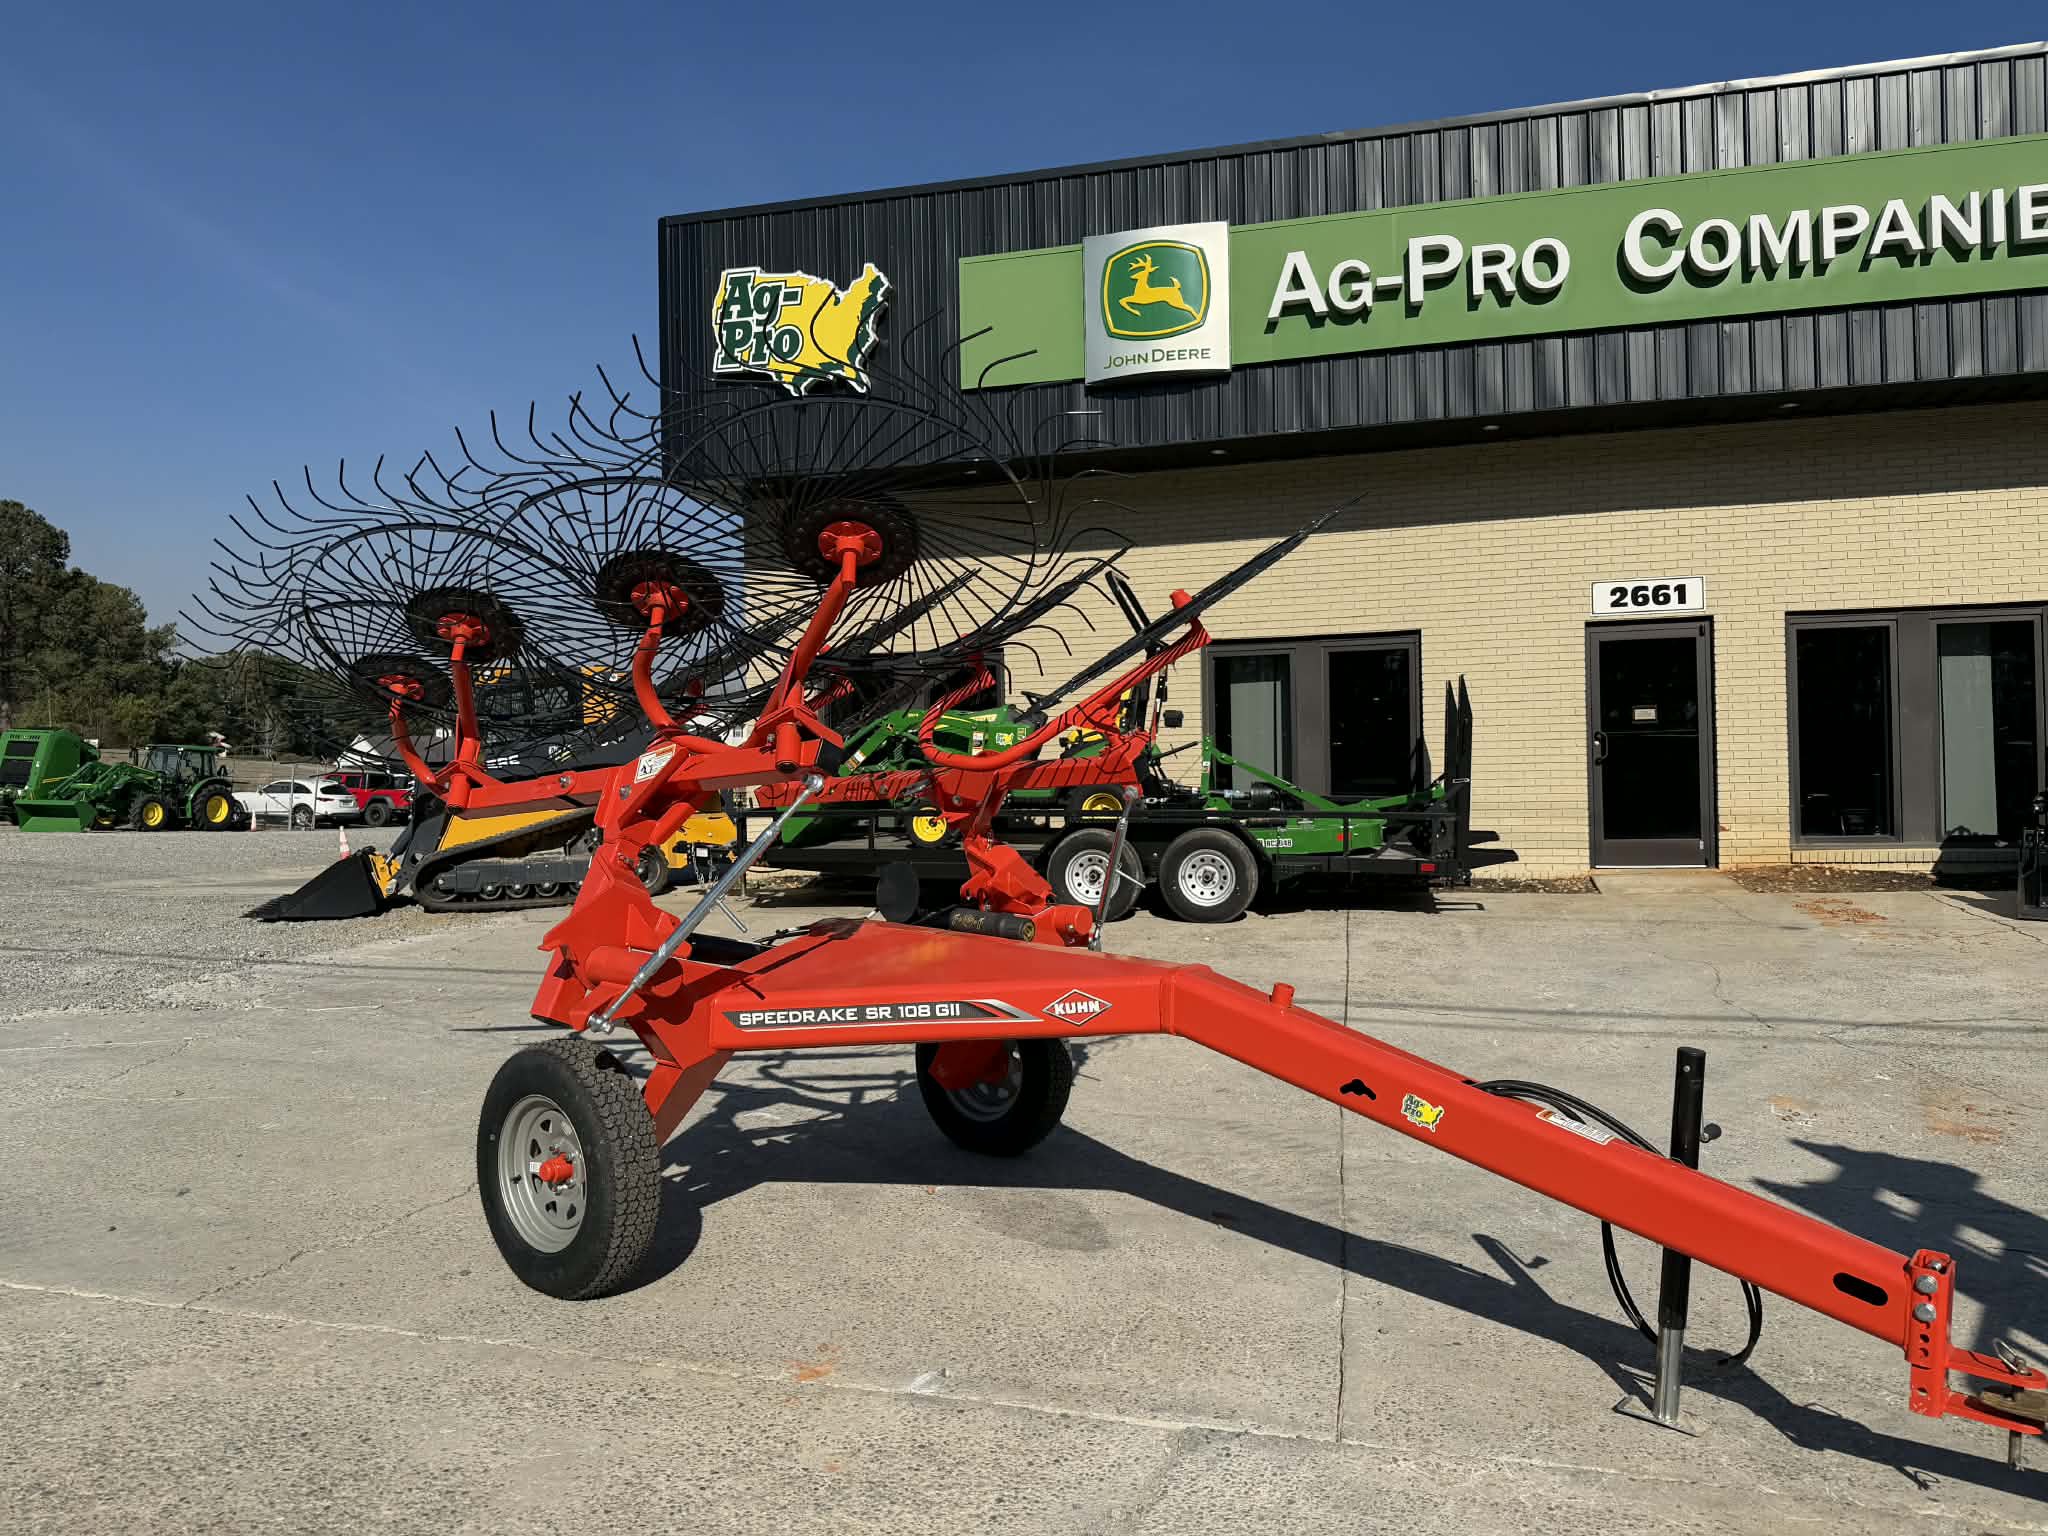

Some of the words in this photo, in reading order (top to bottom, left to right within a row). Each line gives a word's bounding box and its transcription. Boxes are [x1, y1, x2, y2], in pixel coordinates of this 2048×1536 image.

[721, 272, 802, 329] Ag-
[716, 319, 803, 368] Pro
[1103, 351, 1149, 369] JOHN
[1151, 347, 1212, 363] DEERE
[1609, 583, 1687, 608] 2661
[739, 1007, 859, 1026] SPEEDRAKE
[865, 1006, 893, 1020] SR
[898, 1003, 931, 1018] 108
[1054, 1000, 1100, 1015] KUHN
